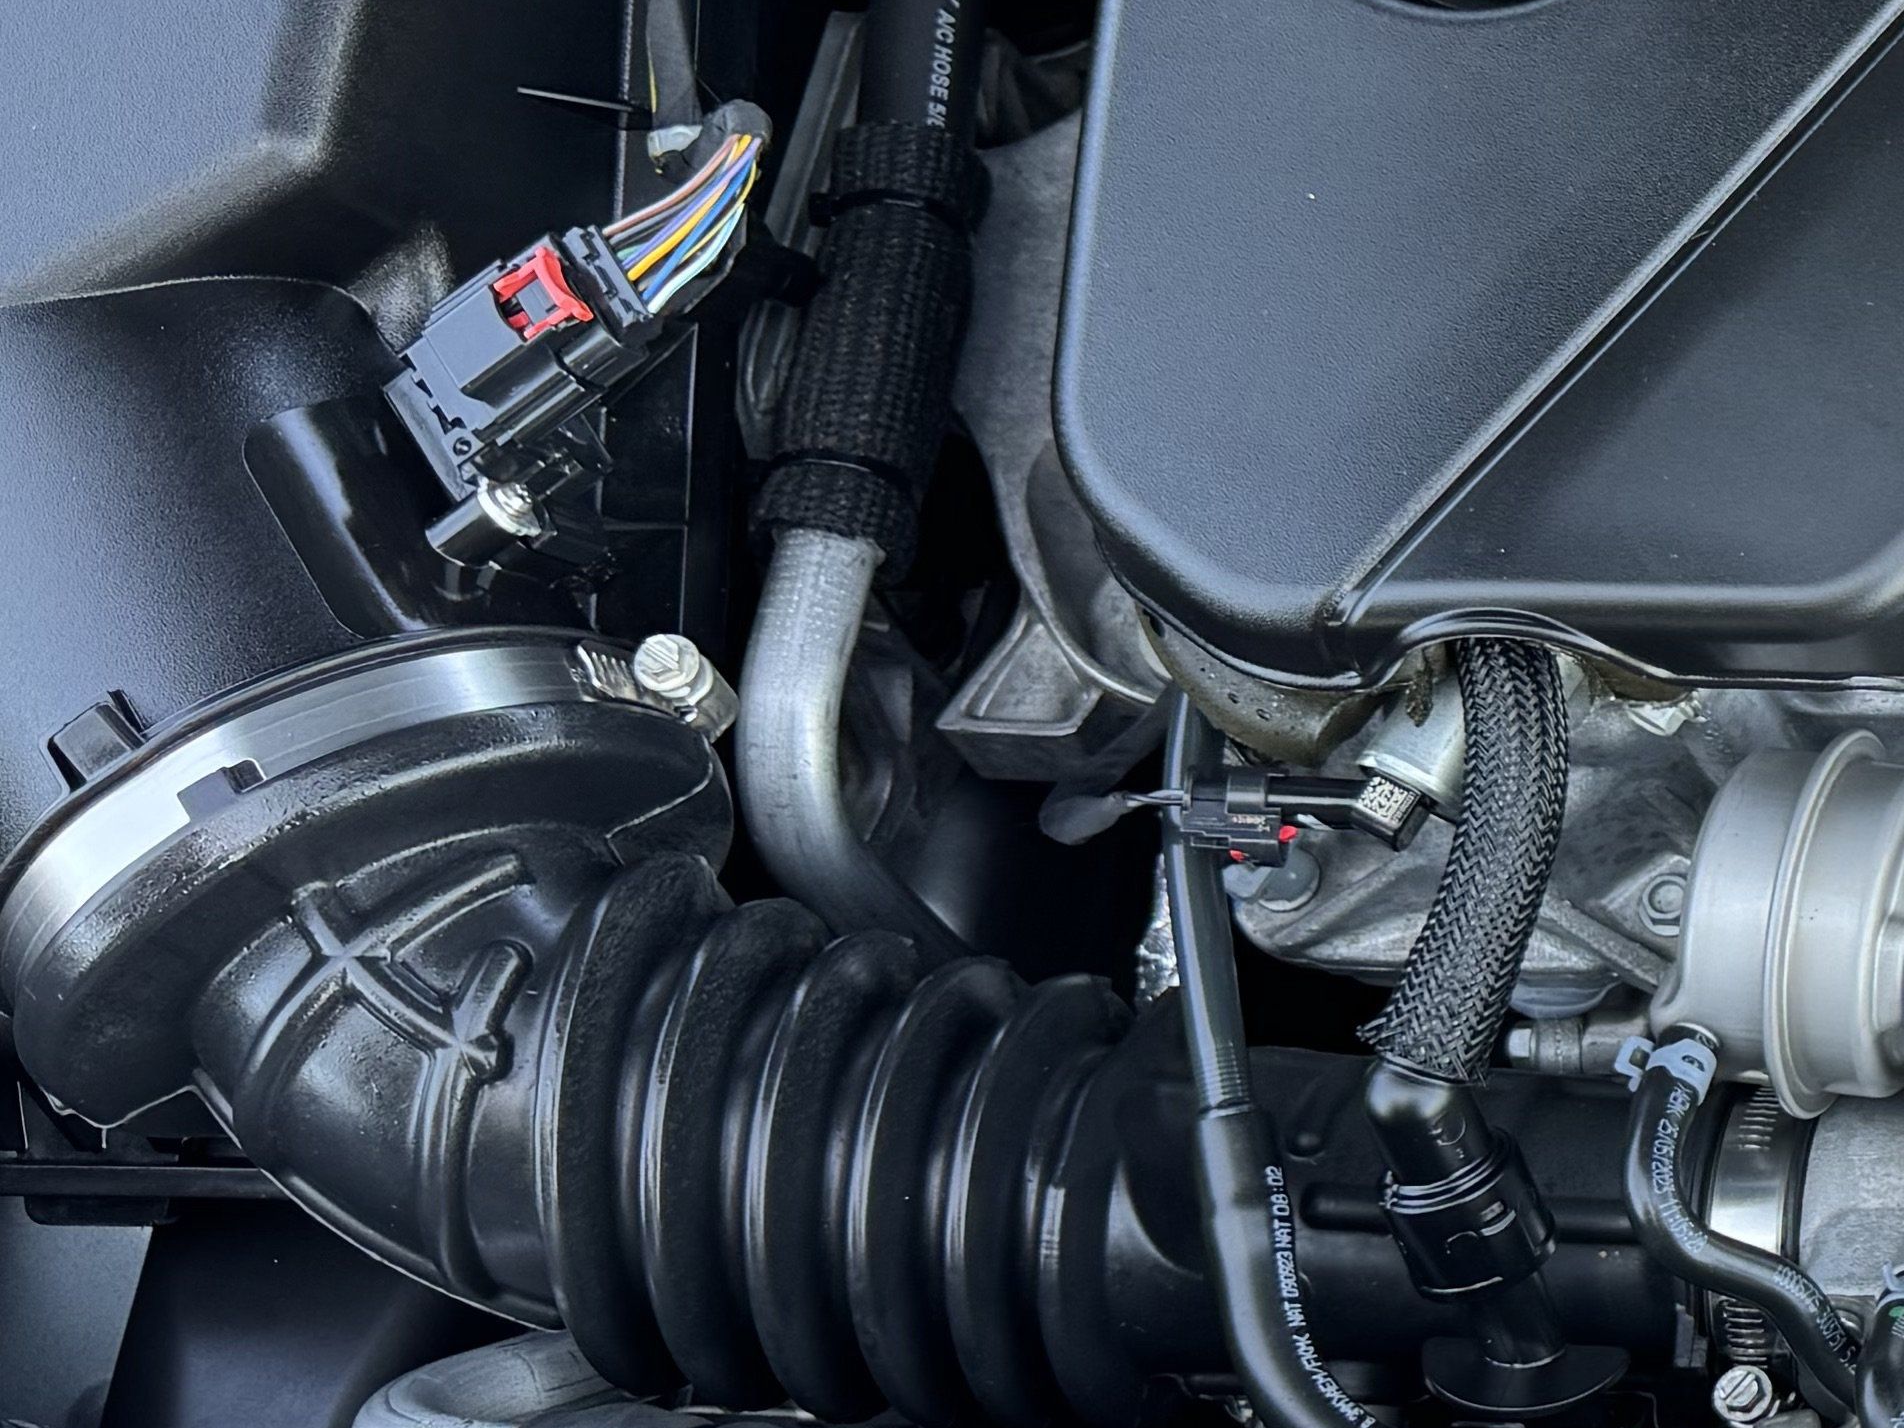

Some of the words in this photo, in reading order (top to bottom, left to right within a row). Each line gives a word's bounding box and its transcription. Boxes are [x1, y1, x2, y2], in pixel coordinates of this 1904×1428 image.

[936, 10, 957, 46] A/C
[929, 44, 954, 102] HOSE
[1264, 1164, 1289, 1217] 08:02
[1274, 1218, 1293, 1249] NAT
[1276, 1250, 1300, 1298] 090923
[1284, 1301, 1307, 1327] NAT
